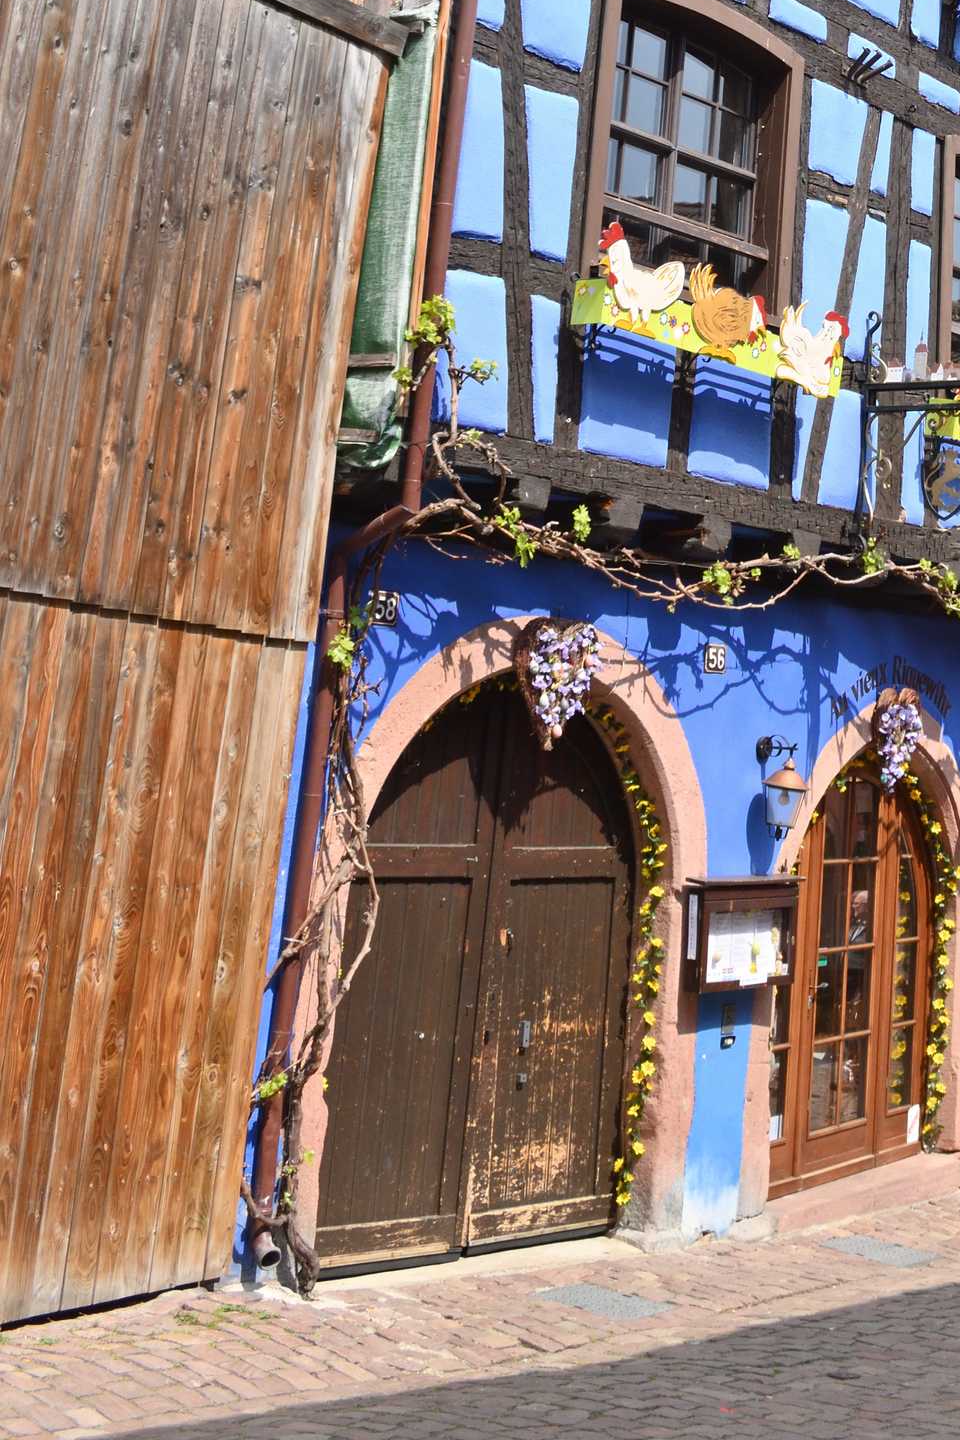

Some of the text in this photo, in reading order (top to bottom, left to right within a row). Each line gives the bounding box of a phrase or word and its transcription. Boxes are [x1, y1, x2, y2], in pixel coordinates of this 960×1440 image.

[375, 597, 397, 620] 58
[708, 647, 725, 670] 56
[851, 663, 888, 703] vieux
